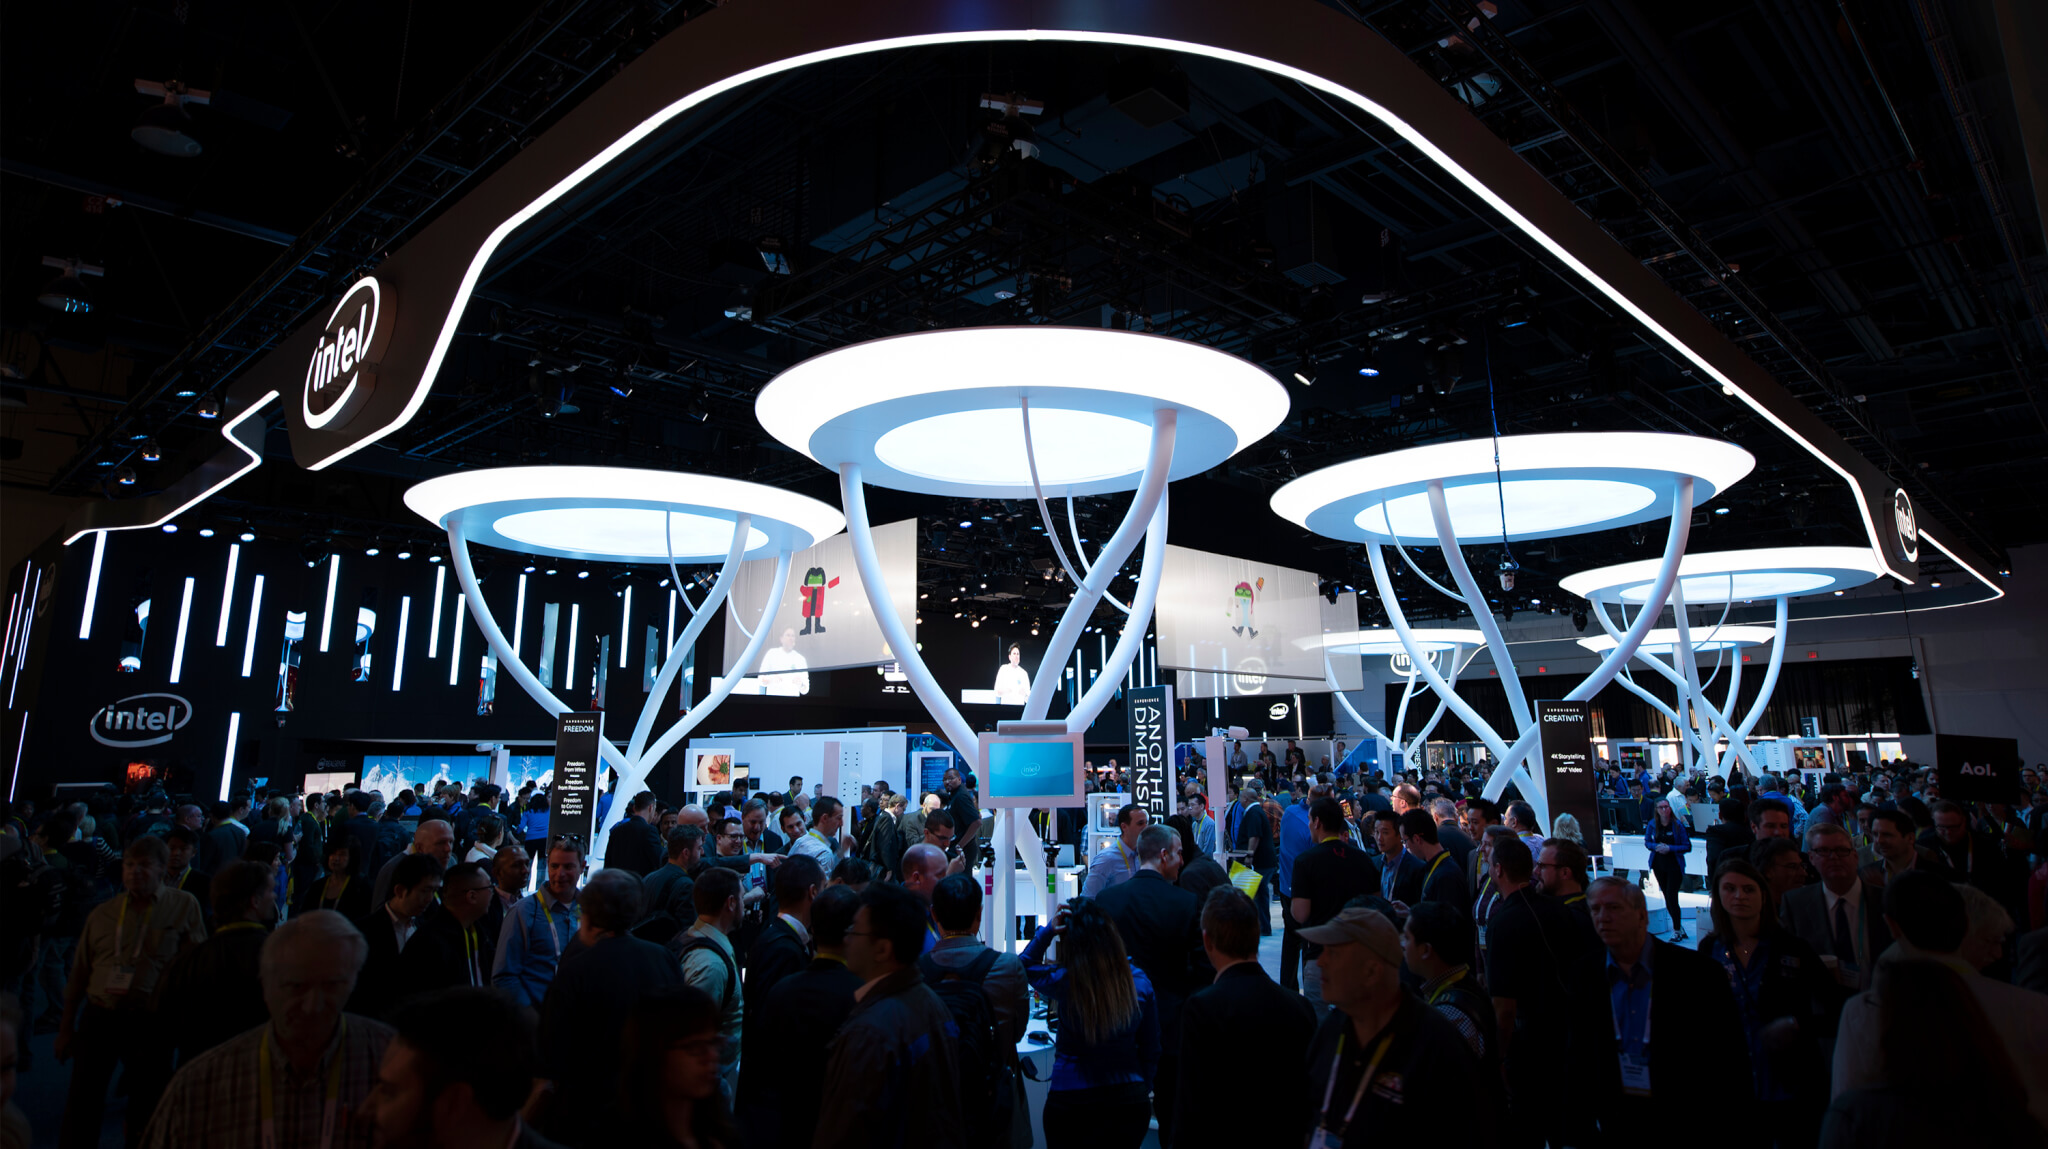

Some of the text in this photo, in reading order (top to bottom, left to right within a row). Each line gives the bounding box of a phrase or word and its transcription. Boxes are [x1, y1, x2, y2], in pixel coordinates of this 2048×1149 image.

[313, 303, 367, 392] intel
[105, 704, 176, 731] intel
[1543, 714, 1584, 722] CREATIVITY
[563, 725, 595, 733] FREEDOM
[1148, 706, 1164, 826] ANOTHER
[1960, 762, 1997, 777] Aol.
